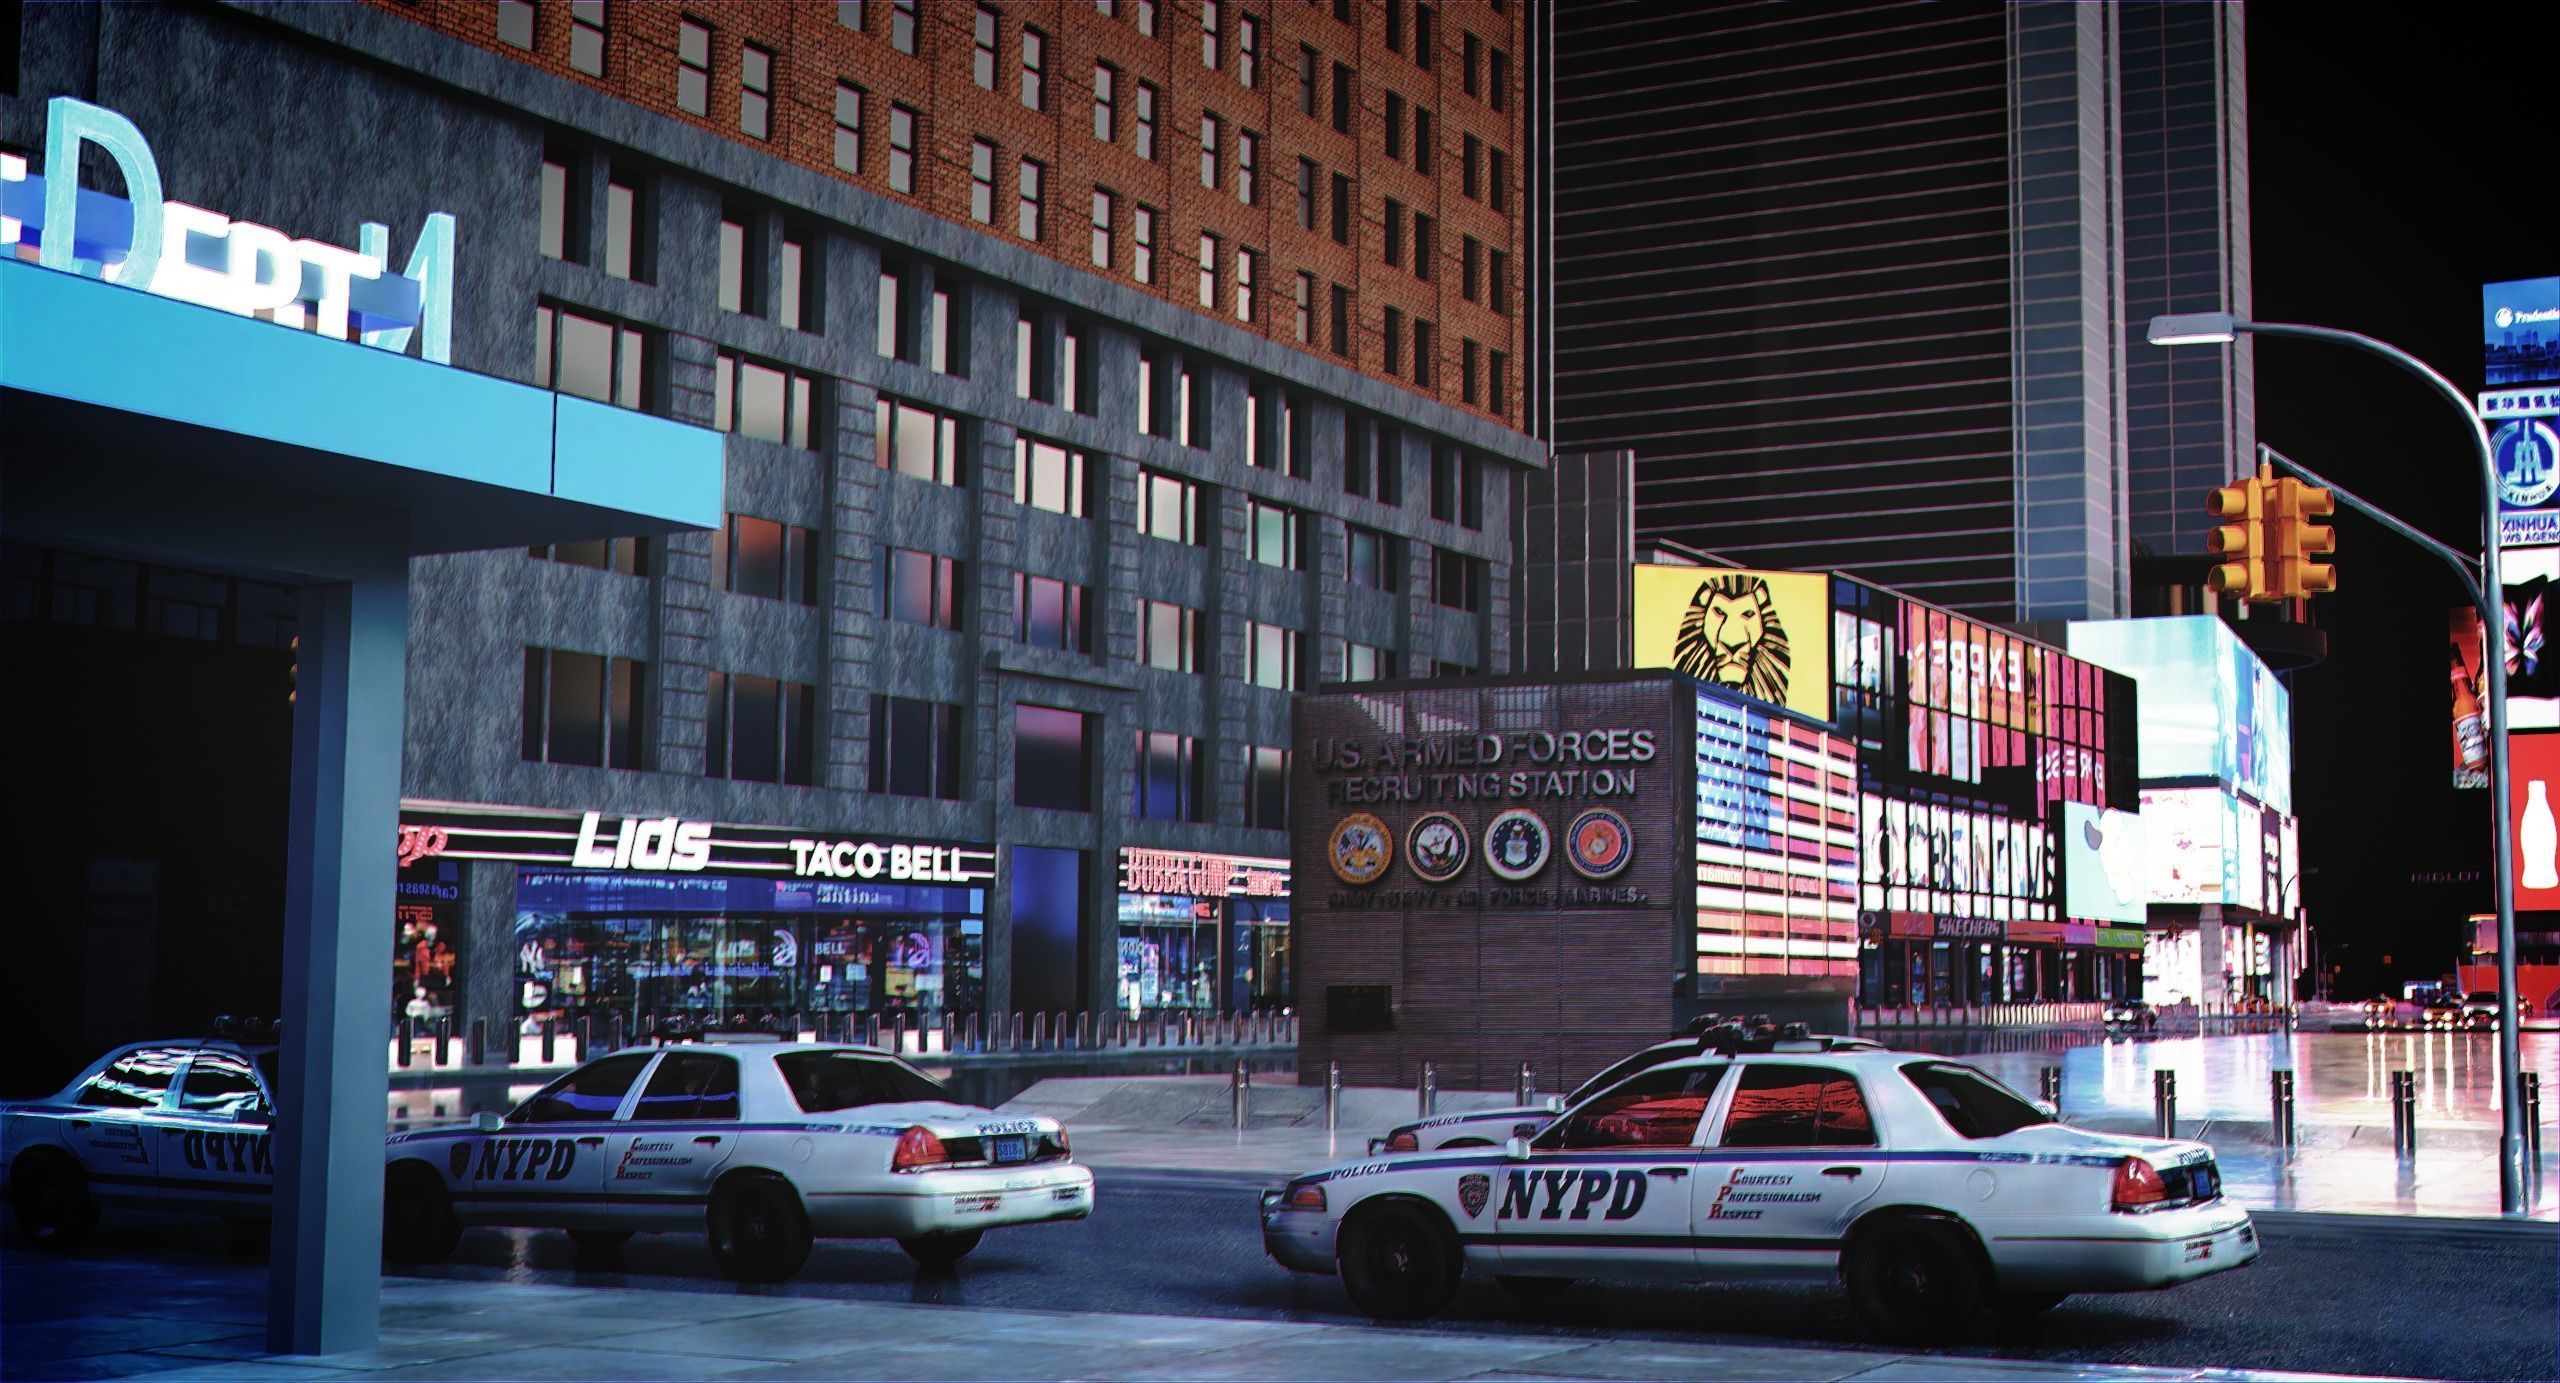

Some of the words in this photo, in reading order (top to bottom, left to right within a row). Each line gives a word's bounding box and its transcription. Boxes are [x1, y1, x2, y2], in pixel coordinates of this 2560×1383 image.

[2501, 517, 2558, 532] XINHUA
[1376, 732, 1502, 768] ARMED
[1508, 728, 1656, 765] FORCES
[1508, 768, 1637, 798] STATION
[789, 839, 884, 879] TACO
[891, 844, 970, 882] BELL
[1939, 917, 2001, 937] SKECHERS
[815, 942, 846, 955] BELL
[977, 1119, 1037, 1135] POLICE
[1420, 1115, 1461, 1129] POLICE
[475, 1139, 577, 1181] NYPD
[1330, 1163, 1387, 1181] POLICE
[1498, 1169, 1647, 1221] NYPD
